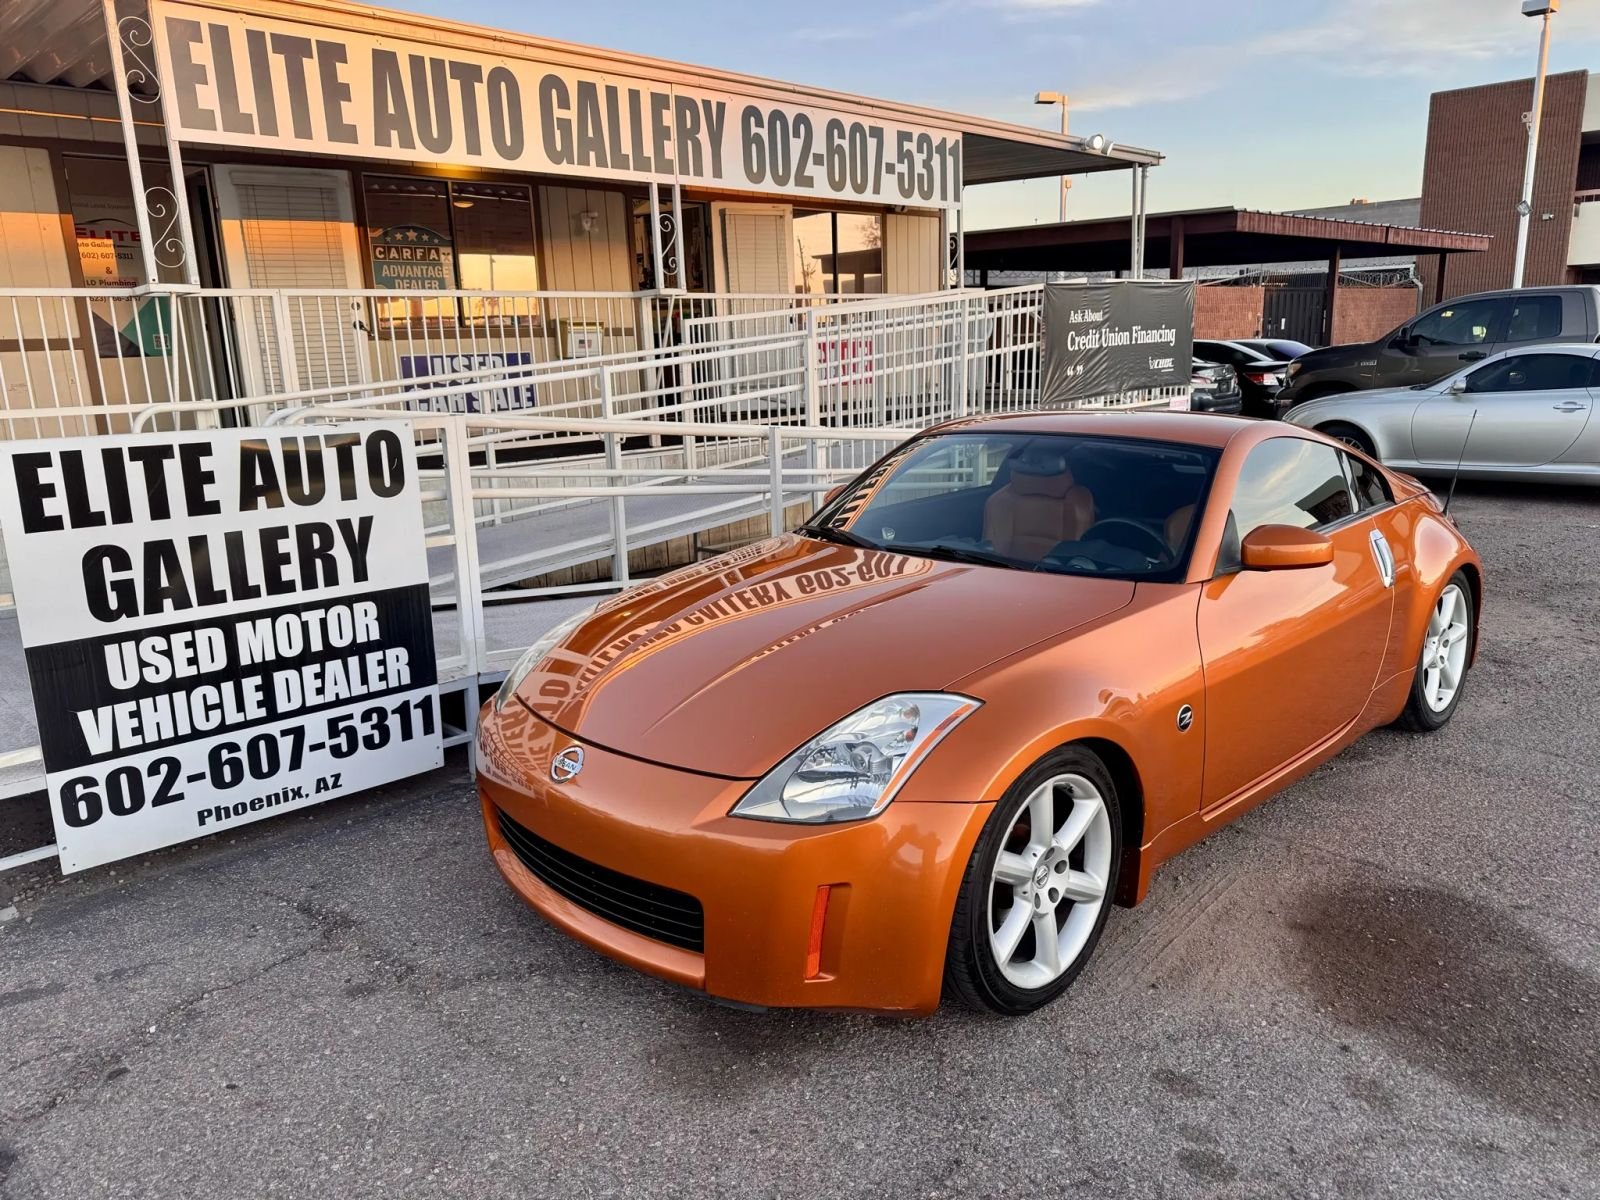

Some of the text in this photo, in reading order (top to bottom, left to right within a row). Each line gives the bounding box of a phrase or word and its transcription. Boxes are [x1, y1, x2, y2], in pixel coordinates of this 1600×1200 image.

[164, 16, 962, 203] ELITE AUTO GALLERY 602-607-5311
[99, 279, 137, 288] Plumbing
[105, 266, 113, 275] &
[382, 264, 449, 278] ADVANTAGE
[395, 279, 439, 290] DEALER
[1067, 324, 1176, 351] Credit Union Financing
[1069, 309, 1103, 323] Ask About
[12, 429, 406, 534] ELITE AUTO
[81, 515, 375, 623] GALLERY
[104, 601, 381, 691] USED MOTOR
[78, 646, 412, 757] VEHICLE DEALER
[59, 694, 436, 829] 602-607-5311
[196, 773, 343, 828] Phoenix, AZ
